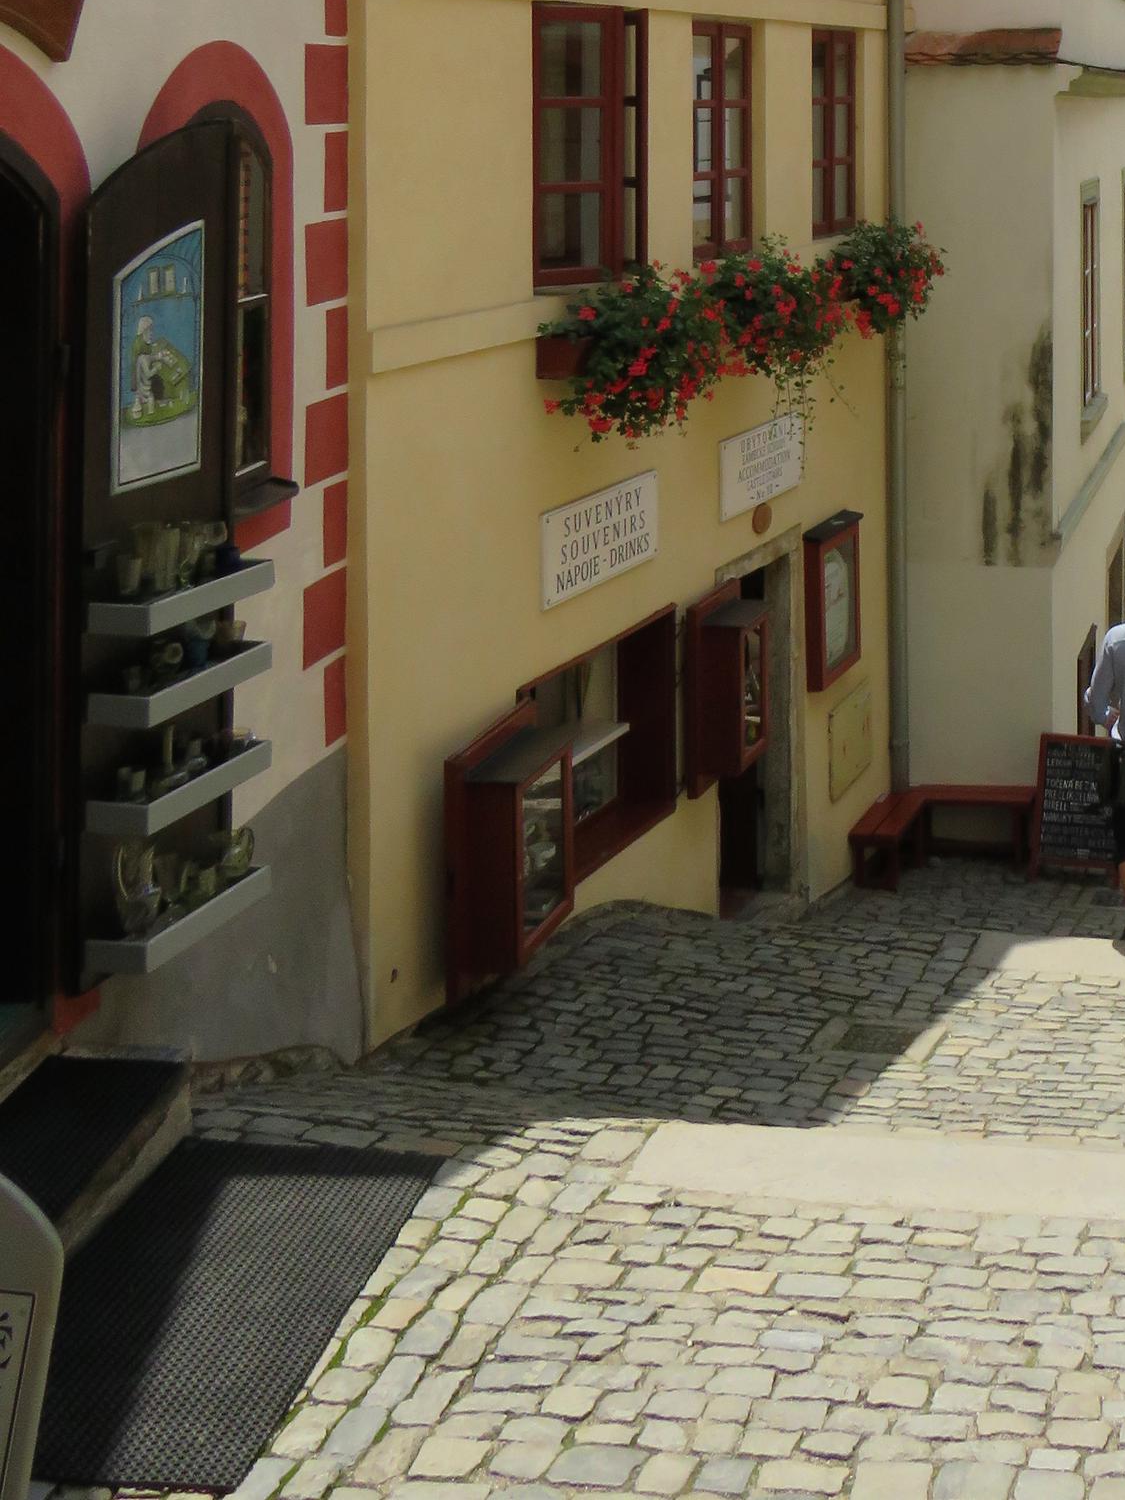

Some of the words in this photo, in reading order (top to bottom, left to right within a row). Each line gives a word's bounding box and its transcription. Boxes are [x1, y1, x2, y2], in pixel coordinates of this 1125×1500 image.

[561, 510, 645, 565] SOUVENIRS
[564, 486, 642, 538] SUVENÝRY
[556, 555, 600, 594] NÁPOJE
[610, 532, 650, 568] DRINKS
